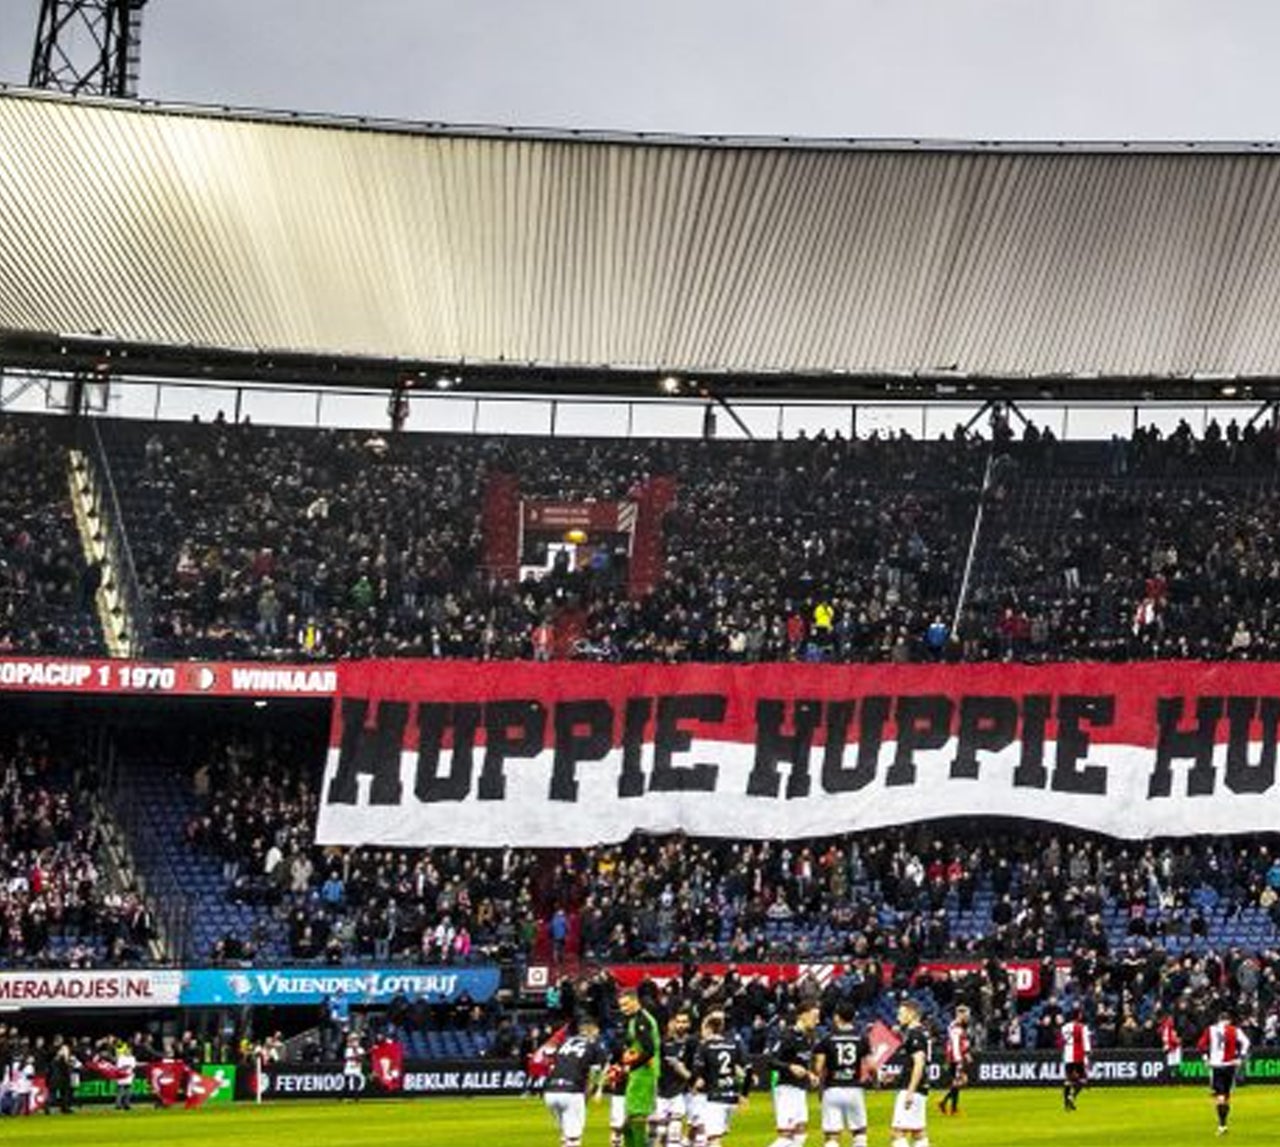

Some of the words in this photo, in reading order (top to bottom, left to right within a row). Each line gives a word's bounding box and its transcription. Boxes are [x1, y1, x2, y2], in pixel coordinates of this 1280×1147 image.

[118, 666, 175, 688] 1970
[327, 694, 726, 804] HUPPIE
[745, 693, 1114, 800] HUPPIE
[718, 1051, 732, 1075] 2
[836, 1043, 857, 1065] 13
[402, 1072, 460, 1091] BEKIJK
[462, 1071, 501, 1089] ALLE
[979, 1063, 1036, 1081] BEKIJK
[1039, 1063, 1066, 1080] ALL
[1088, 1060, 1136, 1080] CTIES
[1141, 1062, 1163, 1078] OP
